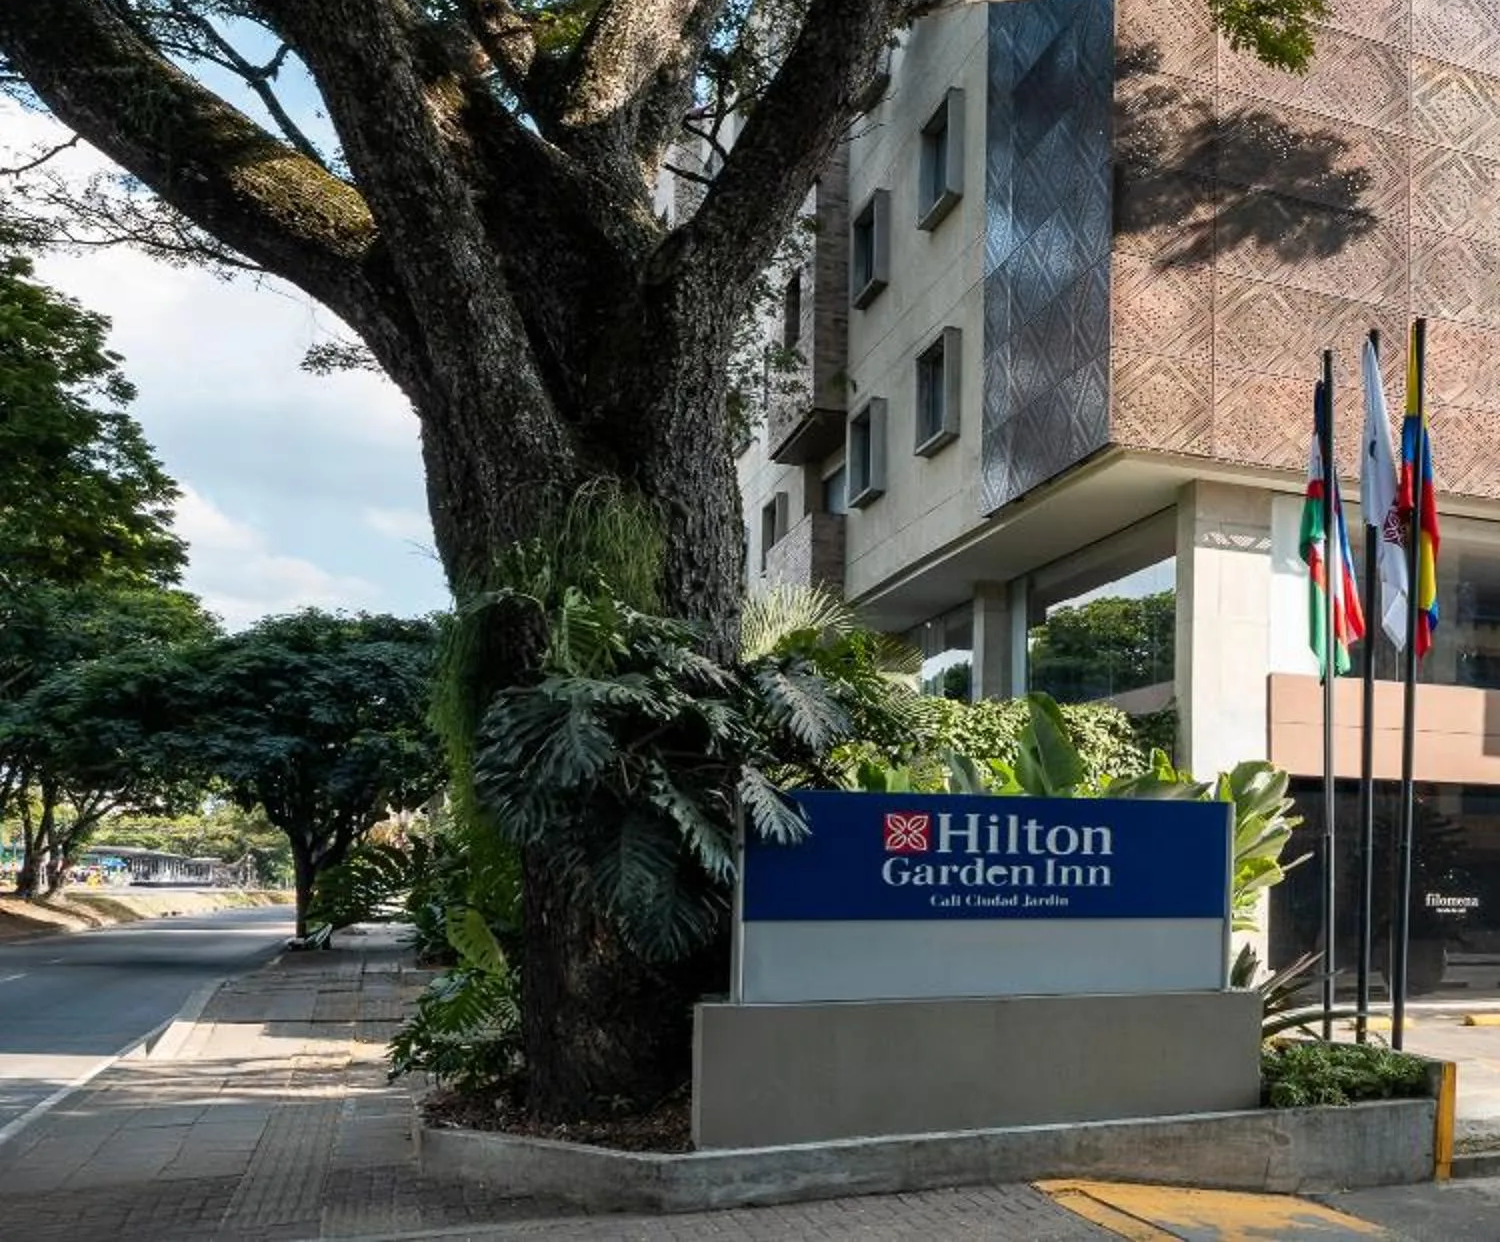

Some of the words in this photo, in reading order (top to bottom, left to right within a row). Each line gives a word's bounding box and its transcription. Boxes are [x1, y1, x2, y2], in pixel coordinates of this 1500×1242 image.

[936, 813, 1113, 855] Hilton
[882, 857, 1036, 886] Garden
[1044, 858, 1113, 886] Inn
[930, 894, 961, 907] Cali
[965, 894, 1018, 907] Ciudad
